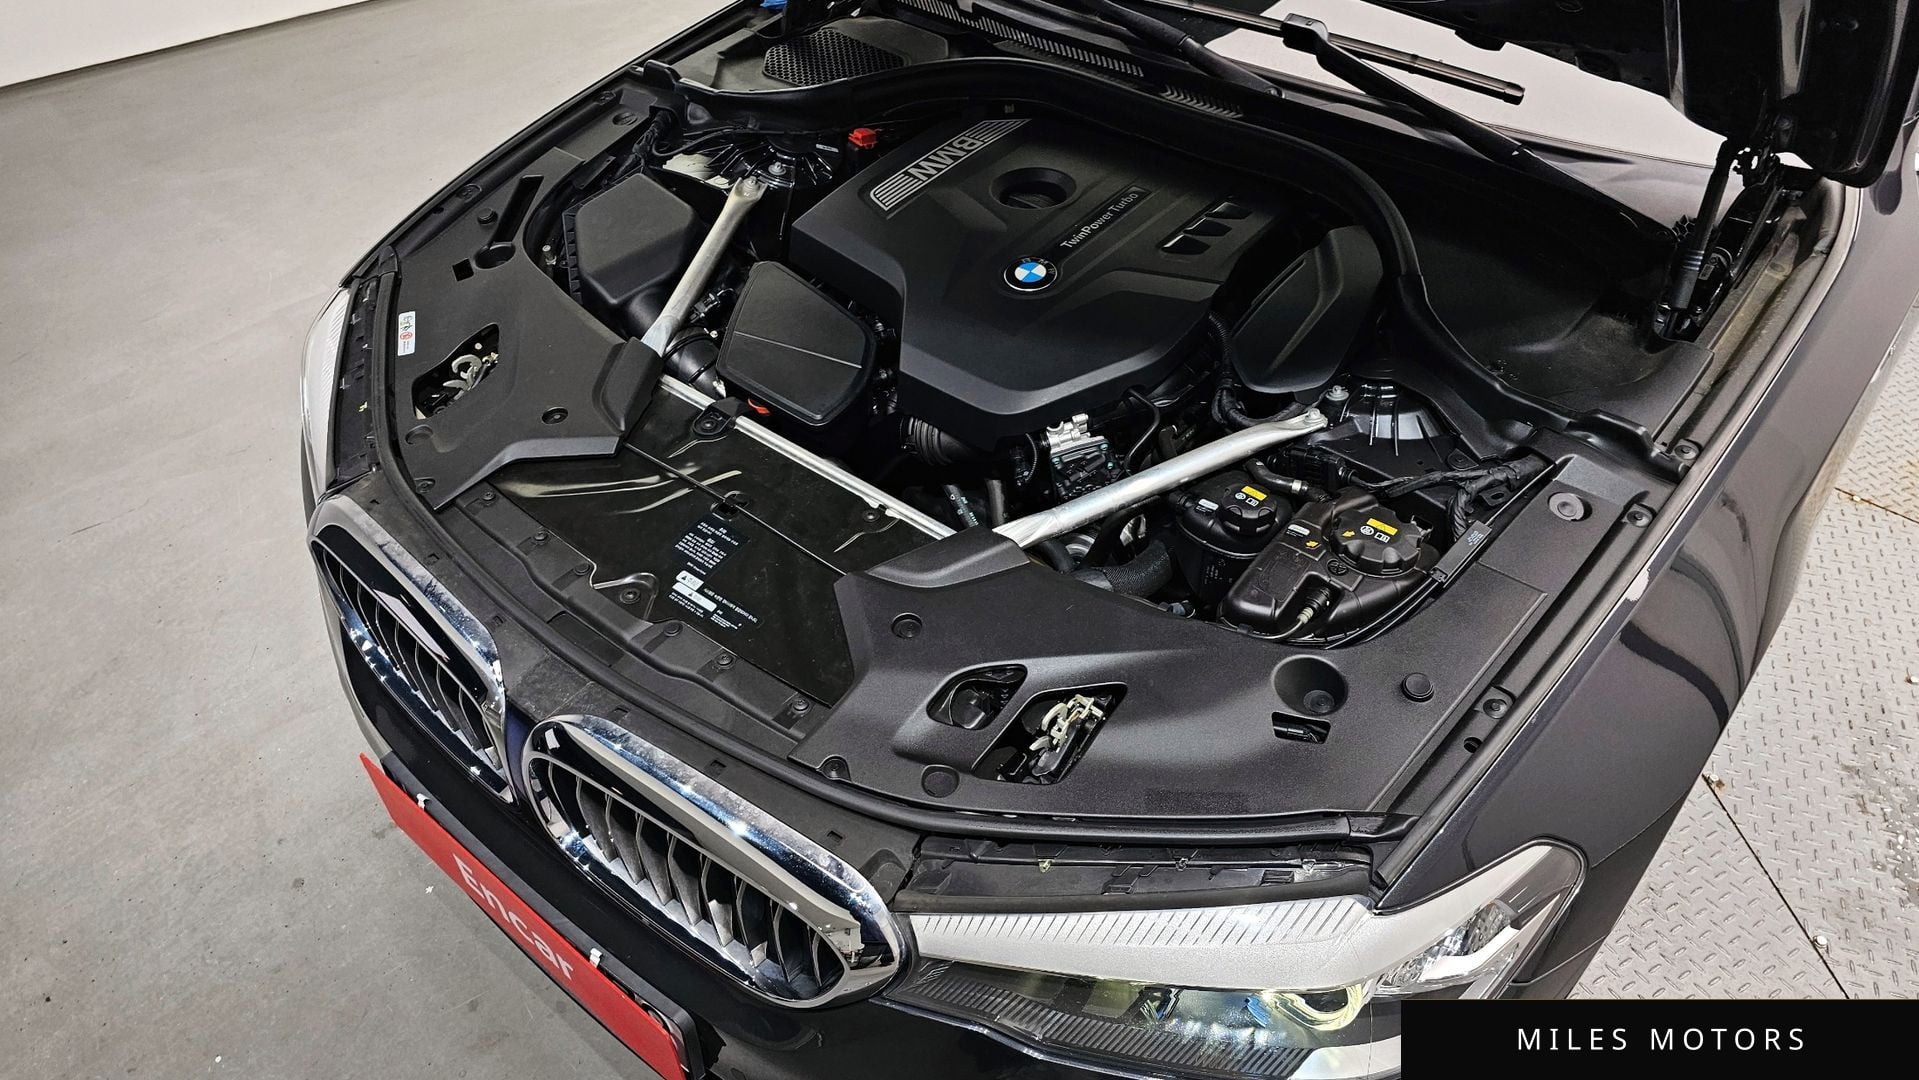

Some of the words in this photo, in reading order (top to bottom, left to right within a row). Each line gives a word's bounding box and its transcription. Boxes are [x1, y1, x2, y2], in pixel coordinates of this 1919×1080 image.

[907, 135, 985, 181] BMW
[1060, 210, 1114, 248] TwinPower
[1108, 193, 1139, 212] Turbo
[453, 853, 574, 981] Encar
